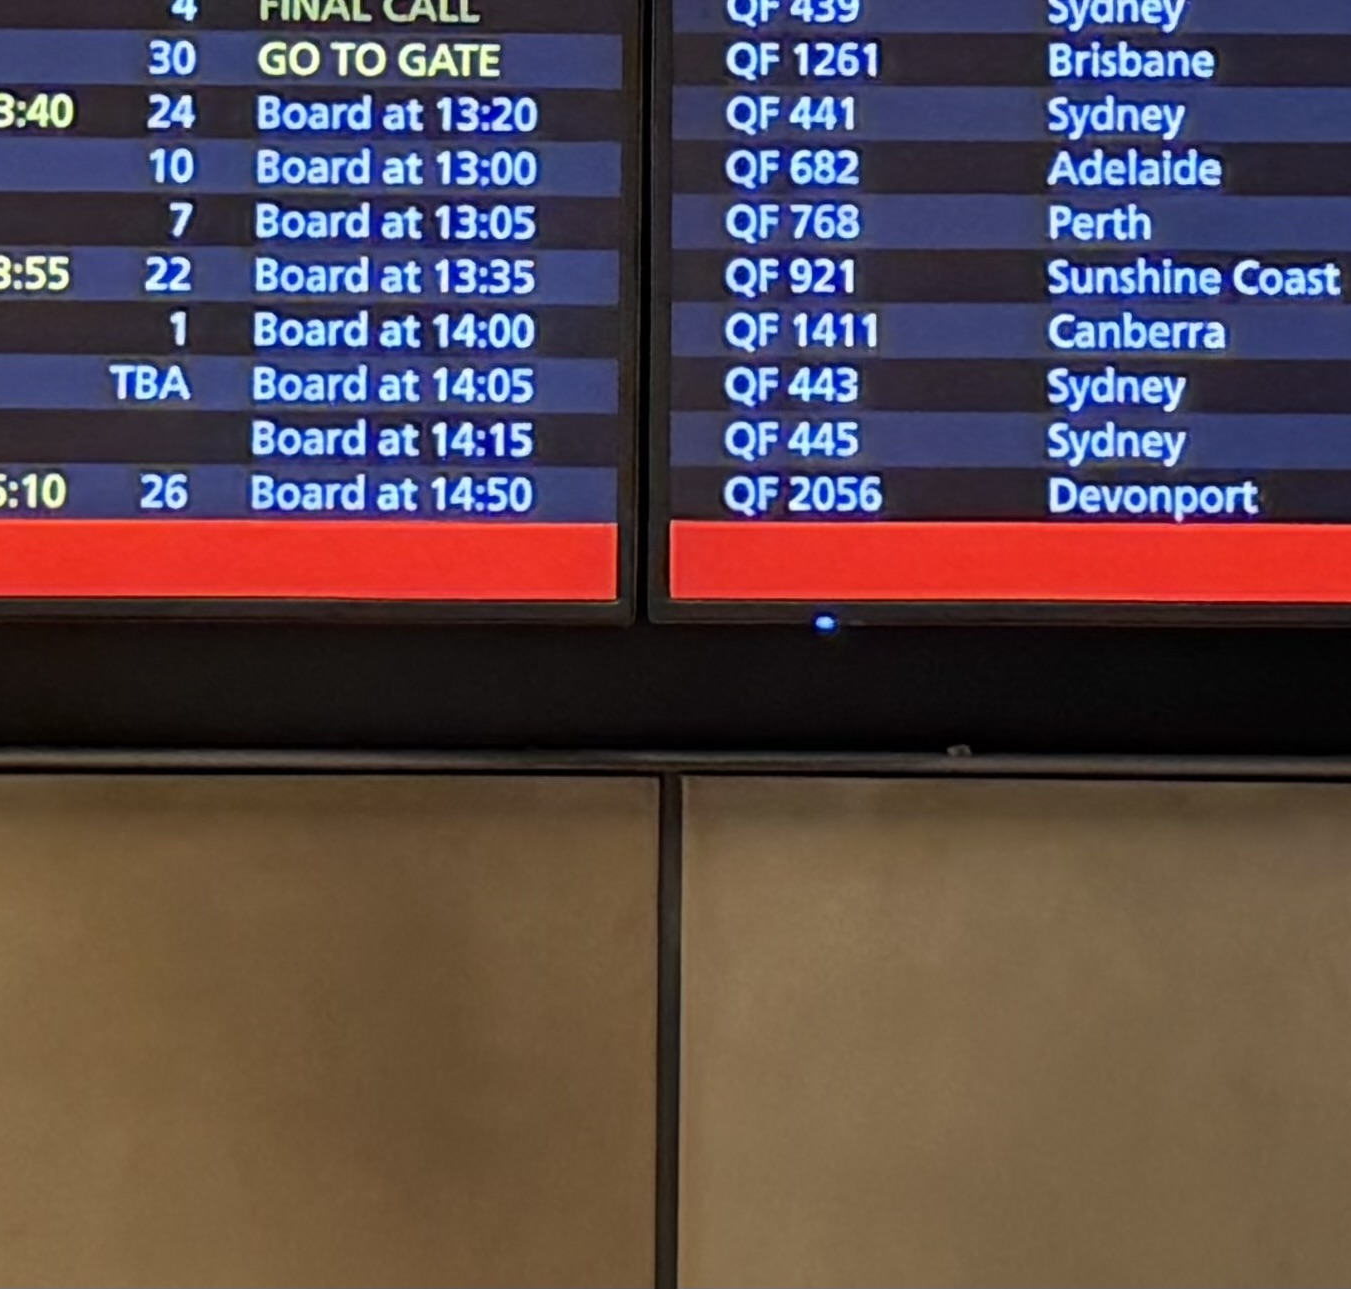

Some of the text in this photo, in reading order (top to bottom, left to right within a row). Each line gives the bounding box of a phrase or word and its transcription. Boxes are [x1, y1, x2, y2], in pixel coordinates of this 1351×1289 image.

[148, 39, 197, 76] 30
[256, 40, 322, 77] GO
[329, 40, 388, 78] TO
[396, 41, 502, 78] GATE
[146, 92, 197, 130] 24
[257, 93, 373, 131] Board
[382, 98, 425, 133] at
[435, 95, 539, 133] 13:20
[143, 255, 192, 292] 22
[254, 255, 370, 294] Board
[379, 259, 422, 295] at
[434, 257, 536, 295] 13:35
[724, 257, 780, 299] QF
[788, 256, 855, 294] 921
[1047, 256, 1223, 297] Sunshine
[1232, 258, 1342, 297] Coast
[724, 311, 780, 354] QF
[792, 311, 878, 349] 1411
[1047, 311, 1227, 350] Canberra
[108, 363, 192, 402] TBA
[252, 363, 369, 403] Board
[377, 368, 421, 403] at
[431, 365, 535, 405] 14:05
[139, 472, 189, 510] 26
[250, 472, 366, 512] Board
[376, 477, 420, 512] at
[430, 475, 534, 513] 14:50
[723, 475, 780, 517] QF
[787, 475, 884, 513] 2056
[1048, 476, 1259, 523] Devonport
